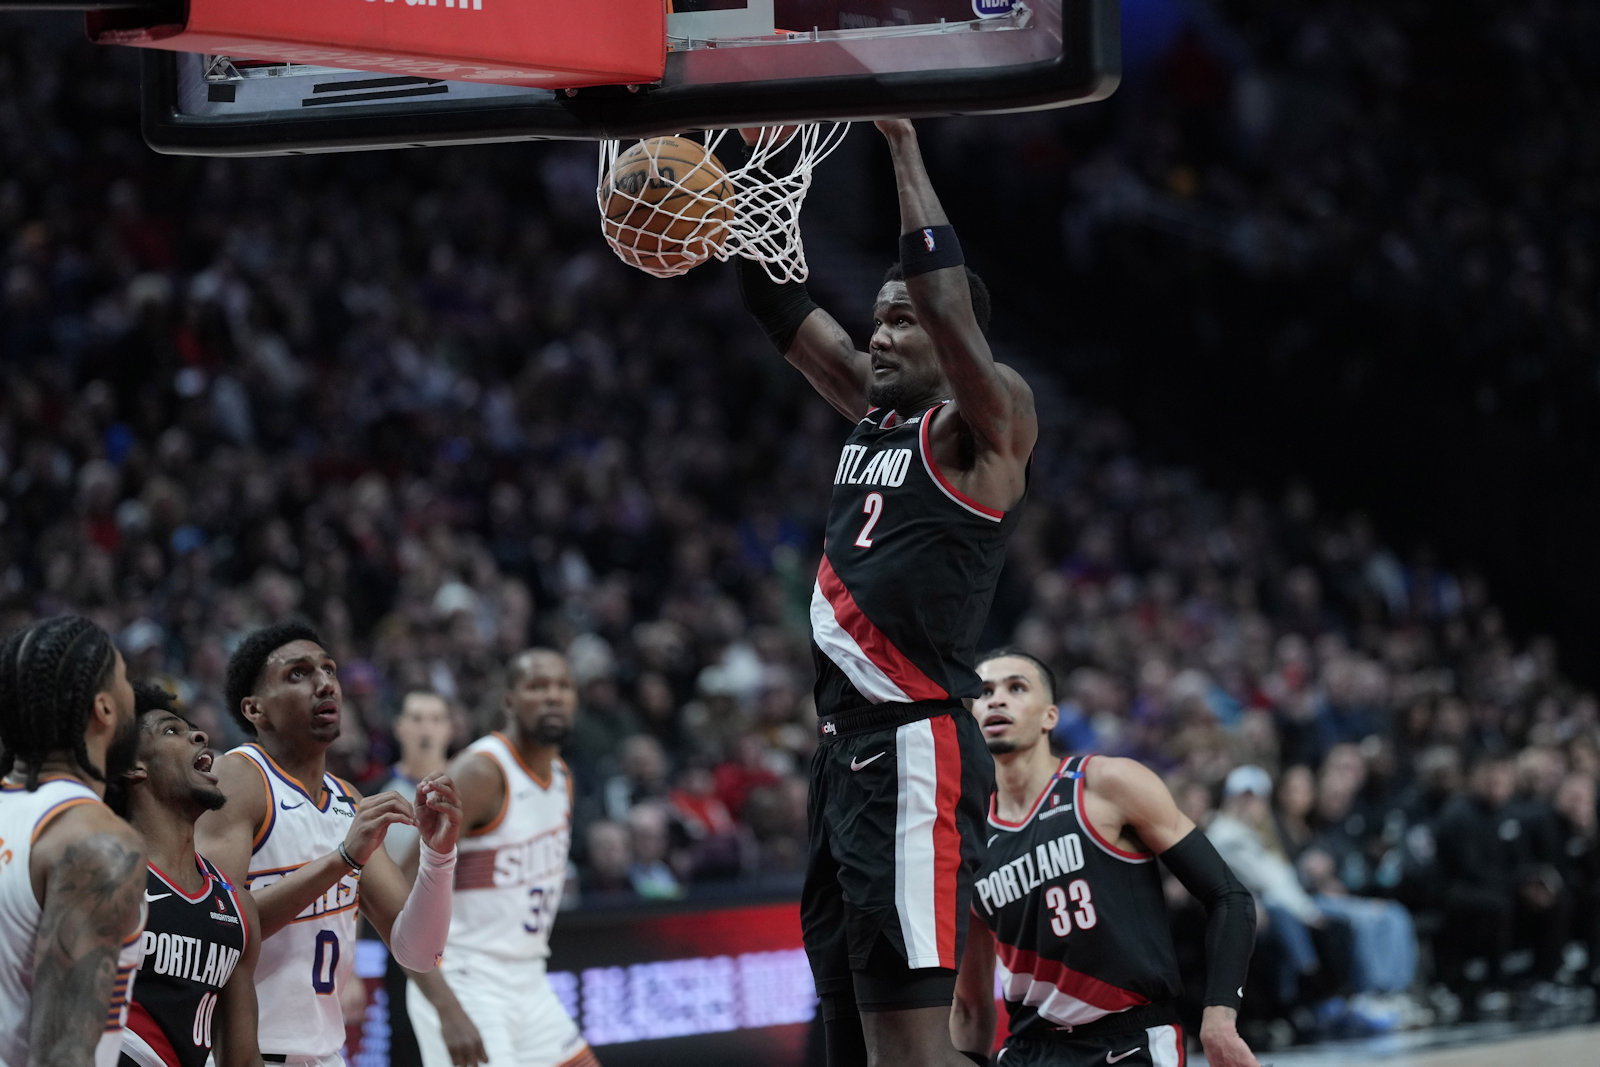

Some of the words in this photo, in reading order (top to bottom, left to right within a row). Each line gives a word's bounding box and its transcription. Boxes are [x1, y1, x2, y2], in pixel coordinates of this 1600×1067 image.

[854, 491, 884, 548] 2
[974, 832, 1085, 917] PORTLAND
[1045, 878, 1098, 938] 33
[138, 930, 241, 989] PORTLAND
[312, 929, 340, 996] 0
[192, 991, 219, 1050] 00
